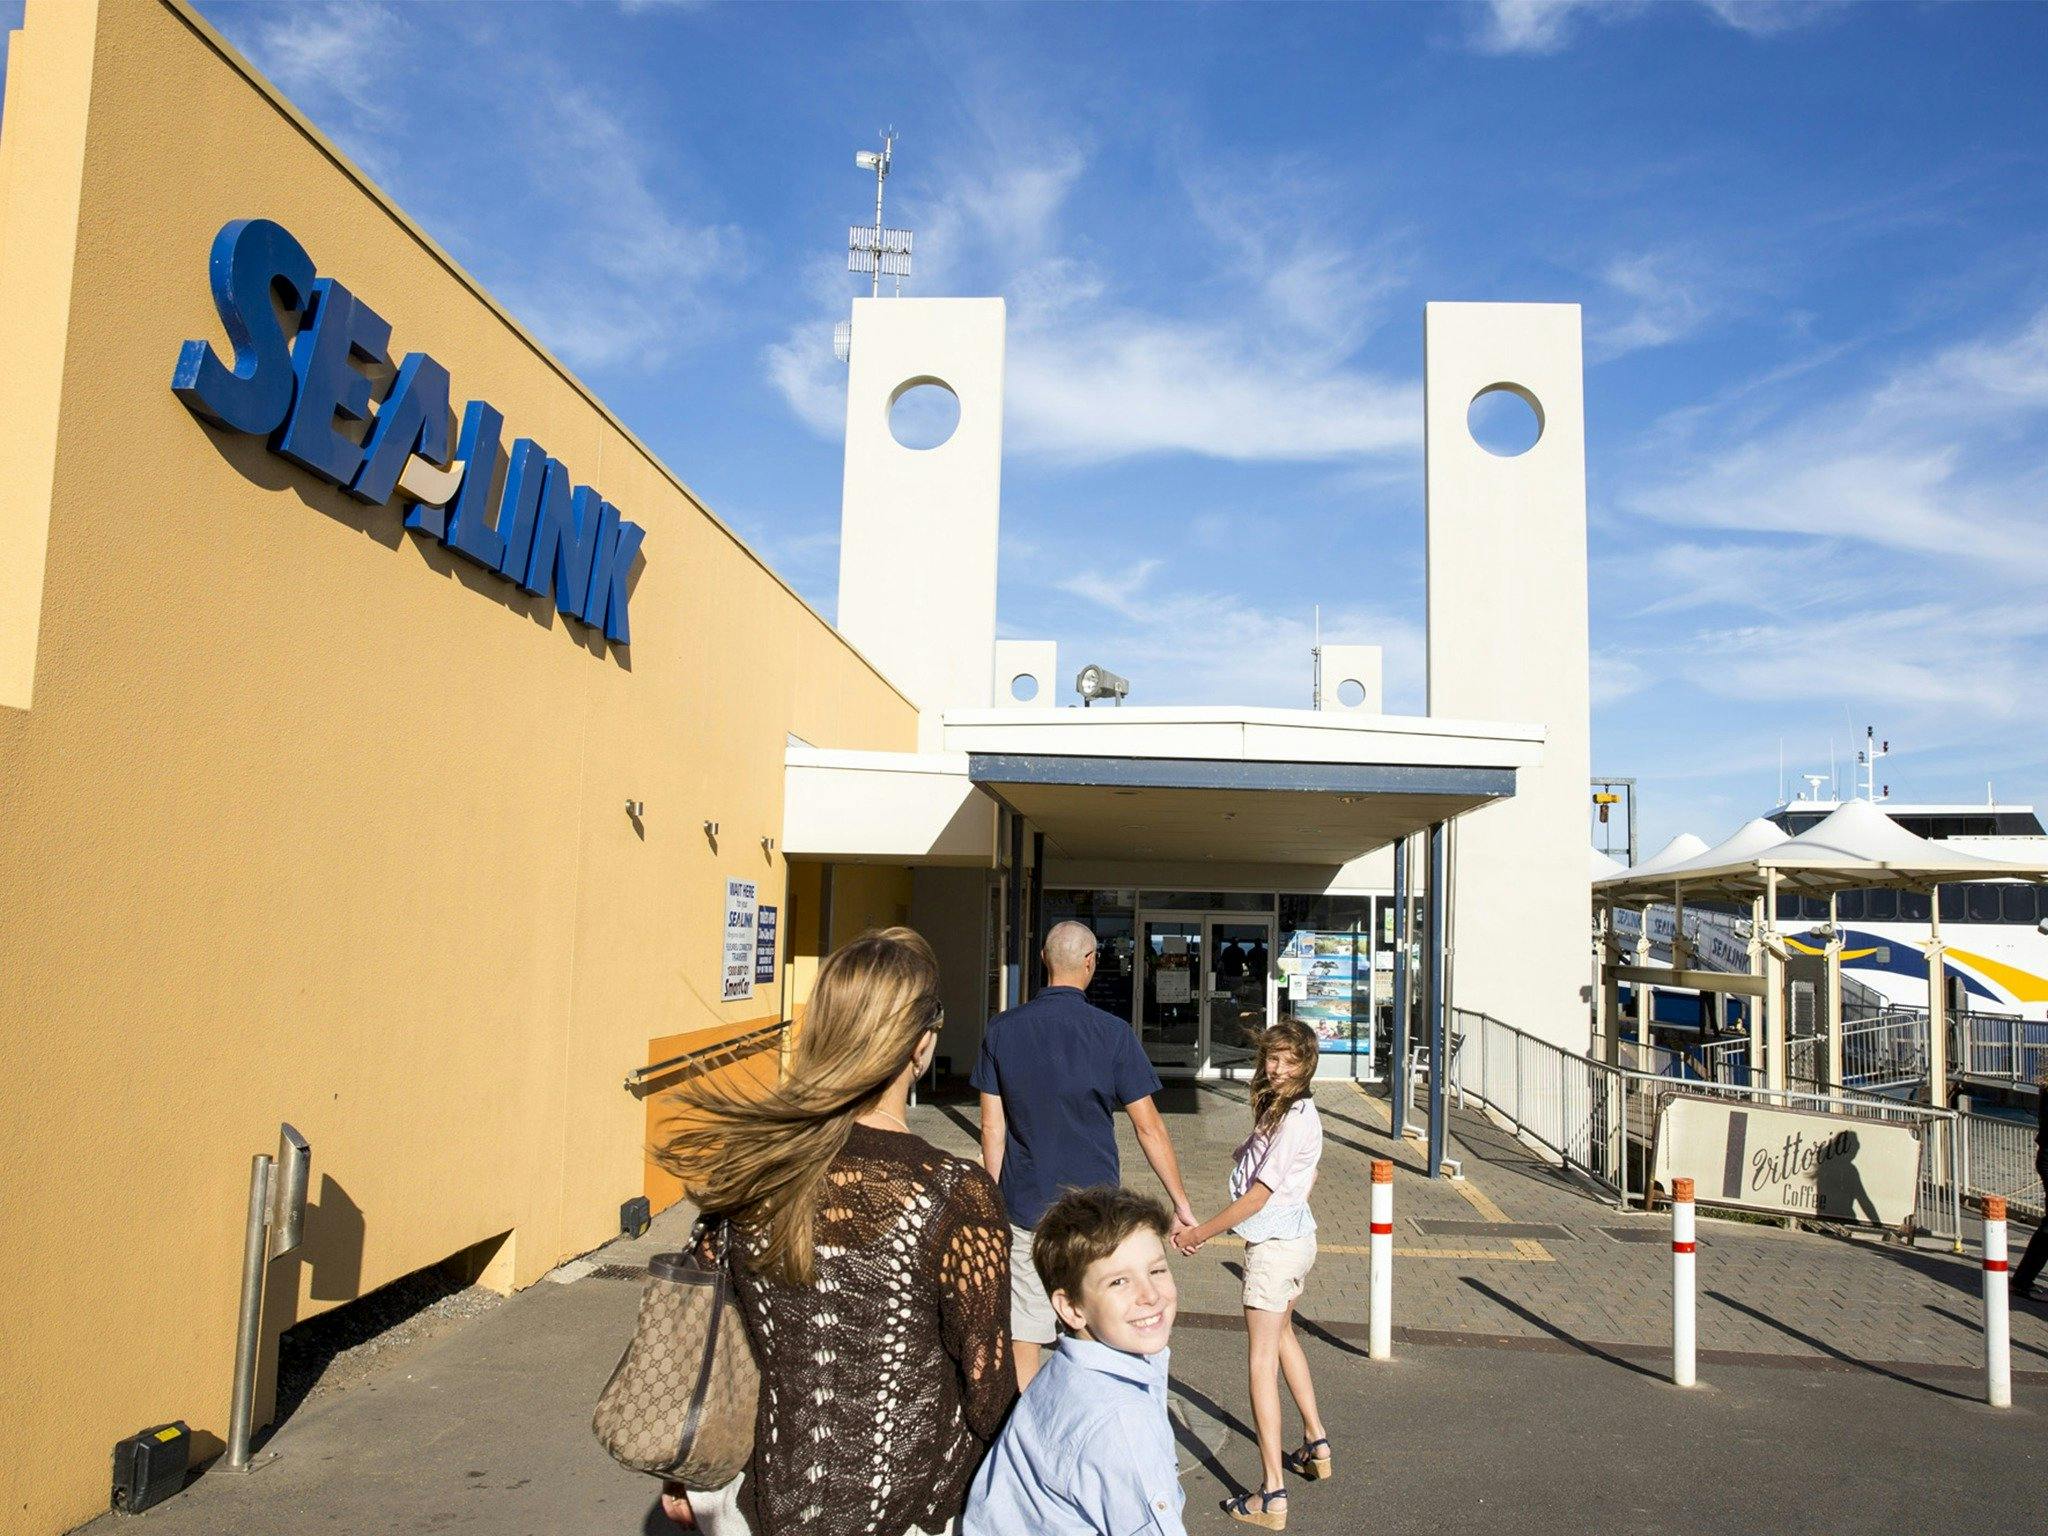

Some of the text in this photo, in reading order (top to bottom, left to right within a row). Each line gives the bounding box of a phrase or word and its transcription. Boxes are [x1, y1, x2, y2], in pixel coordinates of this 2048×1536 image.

[171, 218, 646, 646] SEALINK
[1752, 1130, 1852, 1191] Vittoria
[1782, 1183, 1827, 1210] Coffee
